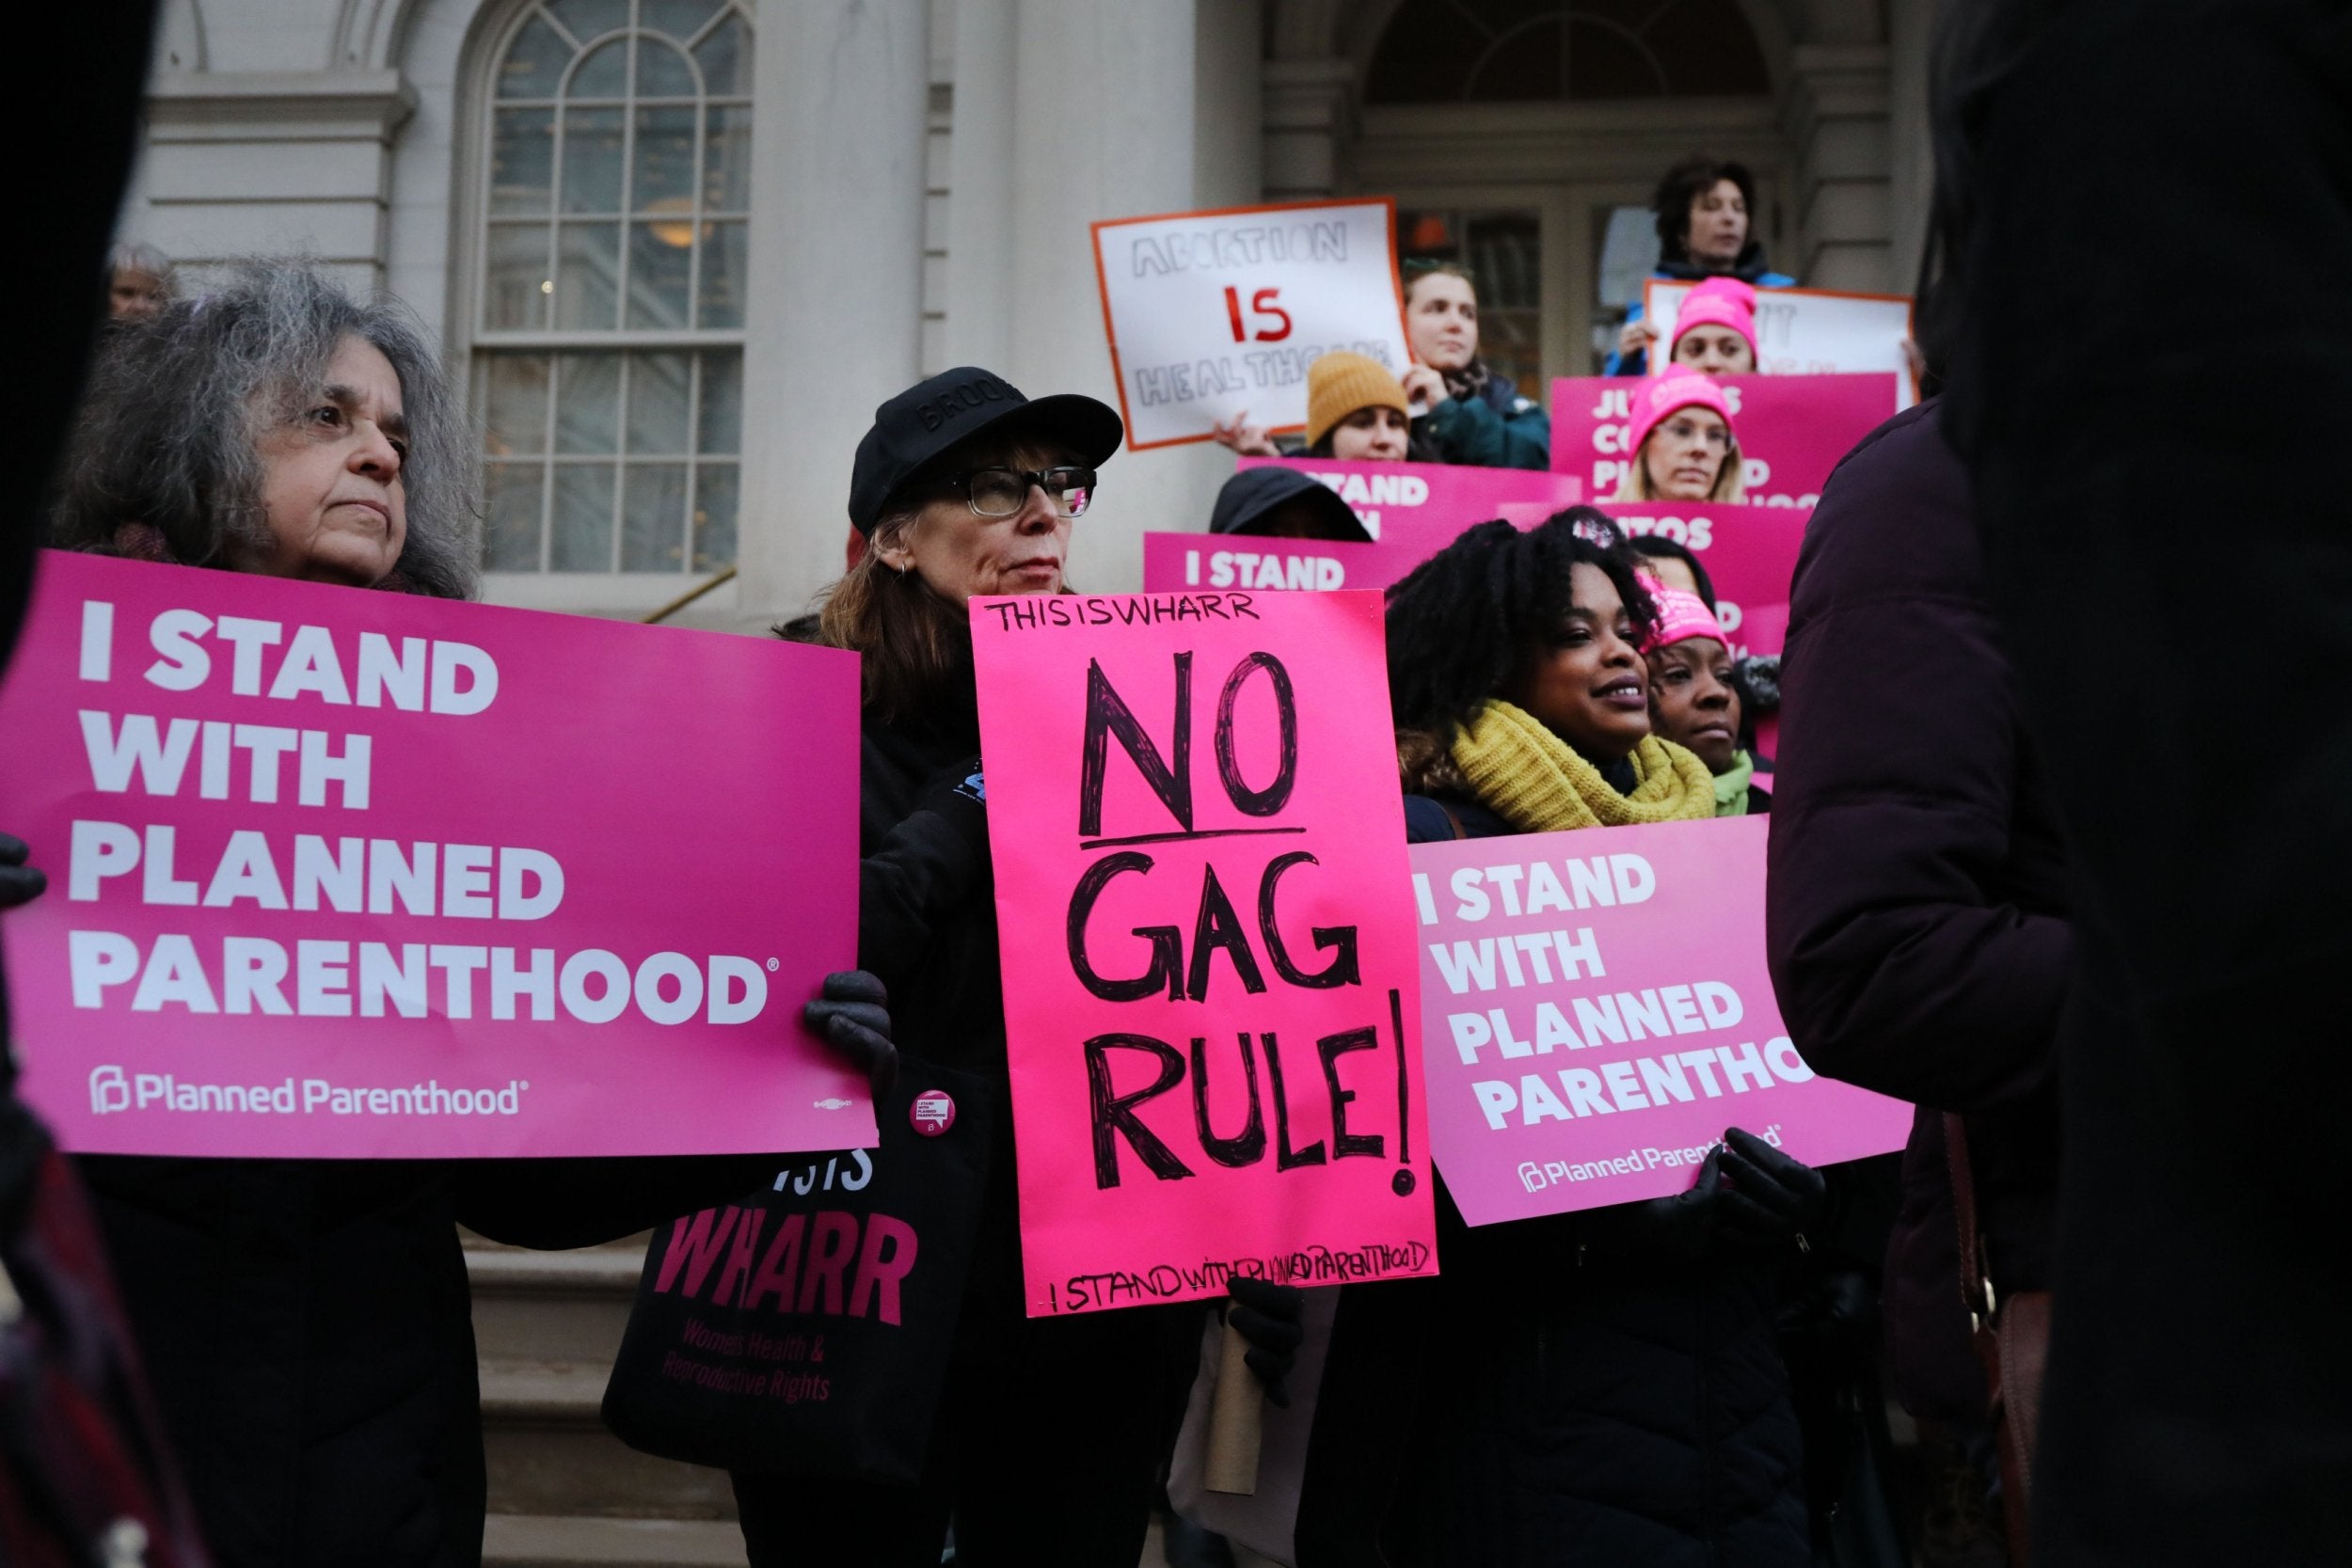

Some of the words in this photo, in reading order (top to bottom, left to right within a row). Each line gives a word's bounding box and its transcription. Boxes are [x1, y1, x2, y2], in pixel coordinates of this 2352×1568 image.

[1224, 285, 1293, 342] IS
[1135, 339, 1394, 407] HEALTHE
[1306, 472, 1429, 507] TAND
[1185, 550, 1200, 585] I
[1209, 551, 1345, 591] STAND
[79, 601, 114, 682] I
[144, 608, 500, 716] STAND
[78, 710, 373, 811] WITH
[1078, 650, 1299, 837] NO
[69, 819, 565, 921] PLANNED
[1411, 873, 1438, 926] I
[1450, 852, 1657, 923] STAND
[1066, 850, 1361, 1004] GAG
[1428, 927, 1606, 994] WITH
[1447, 981, 1744, 1065] PLANNED
[136, 1073, 296, 1113] Planned
[1083, 989, 1418, 1197] RULE!
[1472, 1036, 1817, 1131] PARENTHO
[1544, 1149, 1645, 1185] Planned
[654, 1205, 919, 1328] WHARR
[1049, 1283, 1057, 1313] I
[1066, 1264, 1183, 1310] STAND
[1307, 1240, 1429, 1282] PARENTHOOD
[746, 1332, 806, 1362] Health
[810, 1334, 826, 1364] &
[770, 1370, 830, 1405] Rights
